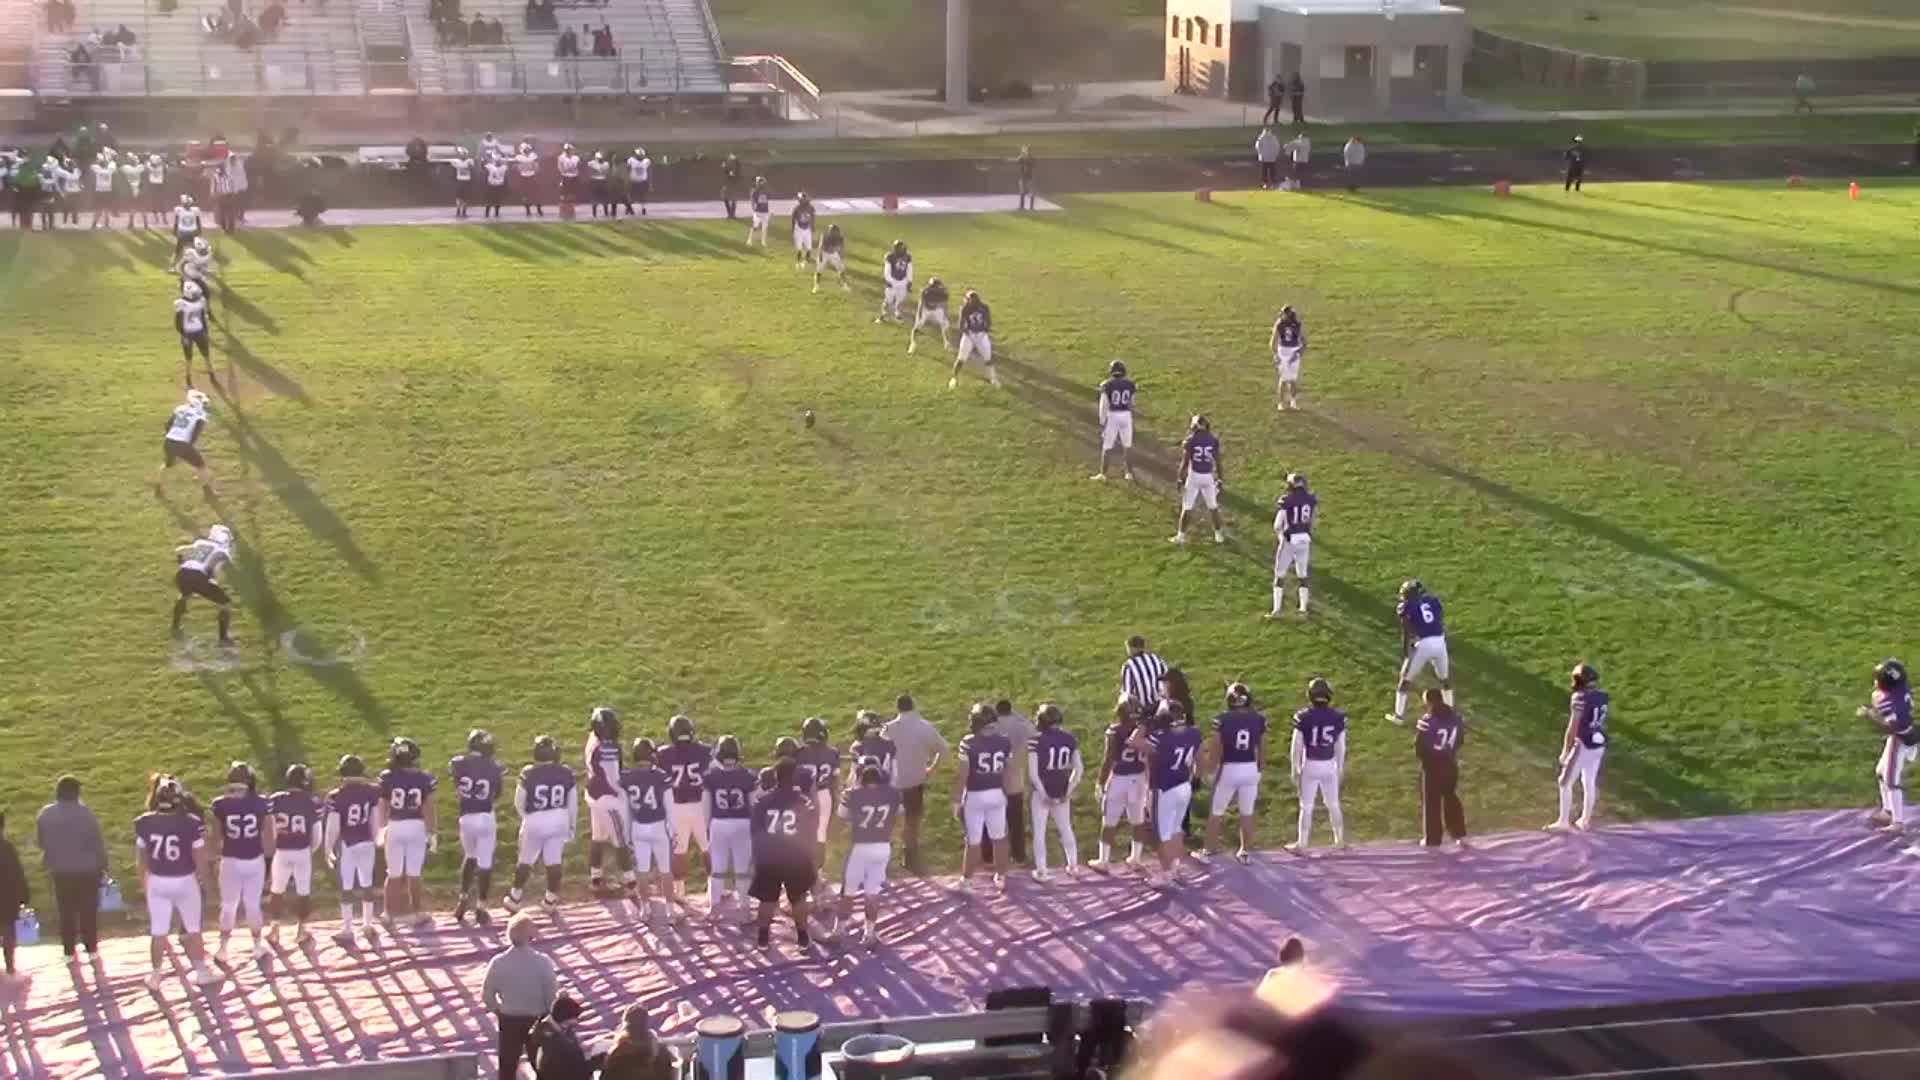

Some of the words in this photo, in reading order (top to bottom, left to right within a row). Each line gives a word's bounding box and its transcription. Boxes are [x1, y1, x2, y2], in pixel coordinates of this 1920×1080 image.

[1193, 446, 1213, 461] 25
[1293, 504, 1311, 524] 18
[1420, 603, 1434, 624] 6
[1235, 729, 1250, 750] 8
[1311, 725, 1335, 747] 15
[976, 750, 1005, 774] 56
[1047, 745, 1070, 770] 10
[671, 762, 703, 787] 75
[391, 788, 422, 809] 83
[458, 776, 490, 800] 23
[533, 784, 565, 808] 58
[628, 785, 657, 810] 24
[715, 788, 745, 810] 63
[347, 801, 370, 826] 81
[767, 809, 797, 835] 72
[859, 804, 890, 828] 77
[226, 814, 258, 839] 52
[150, 833, 180, 862] 76
